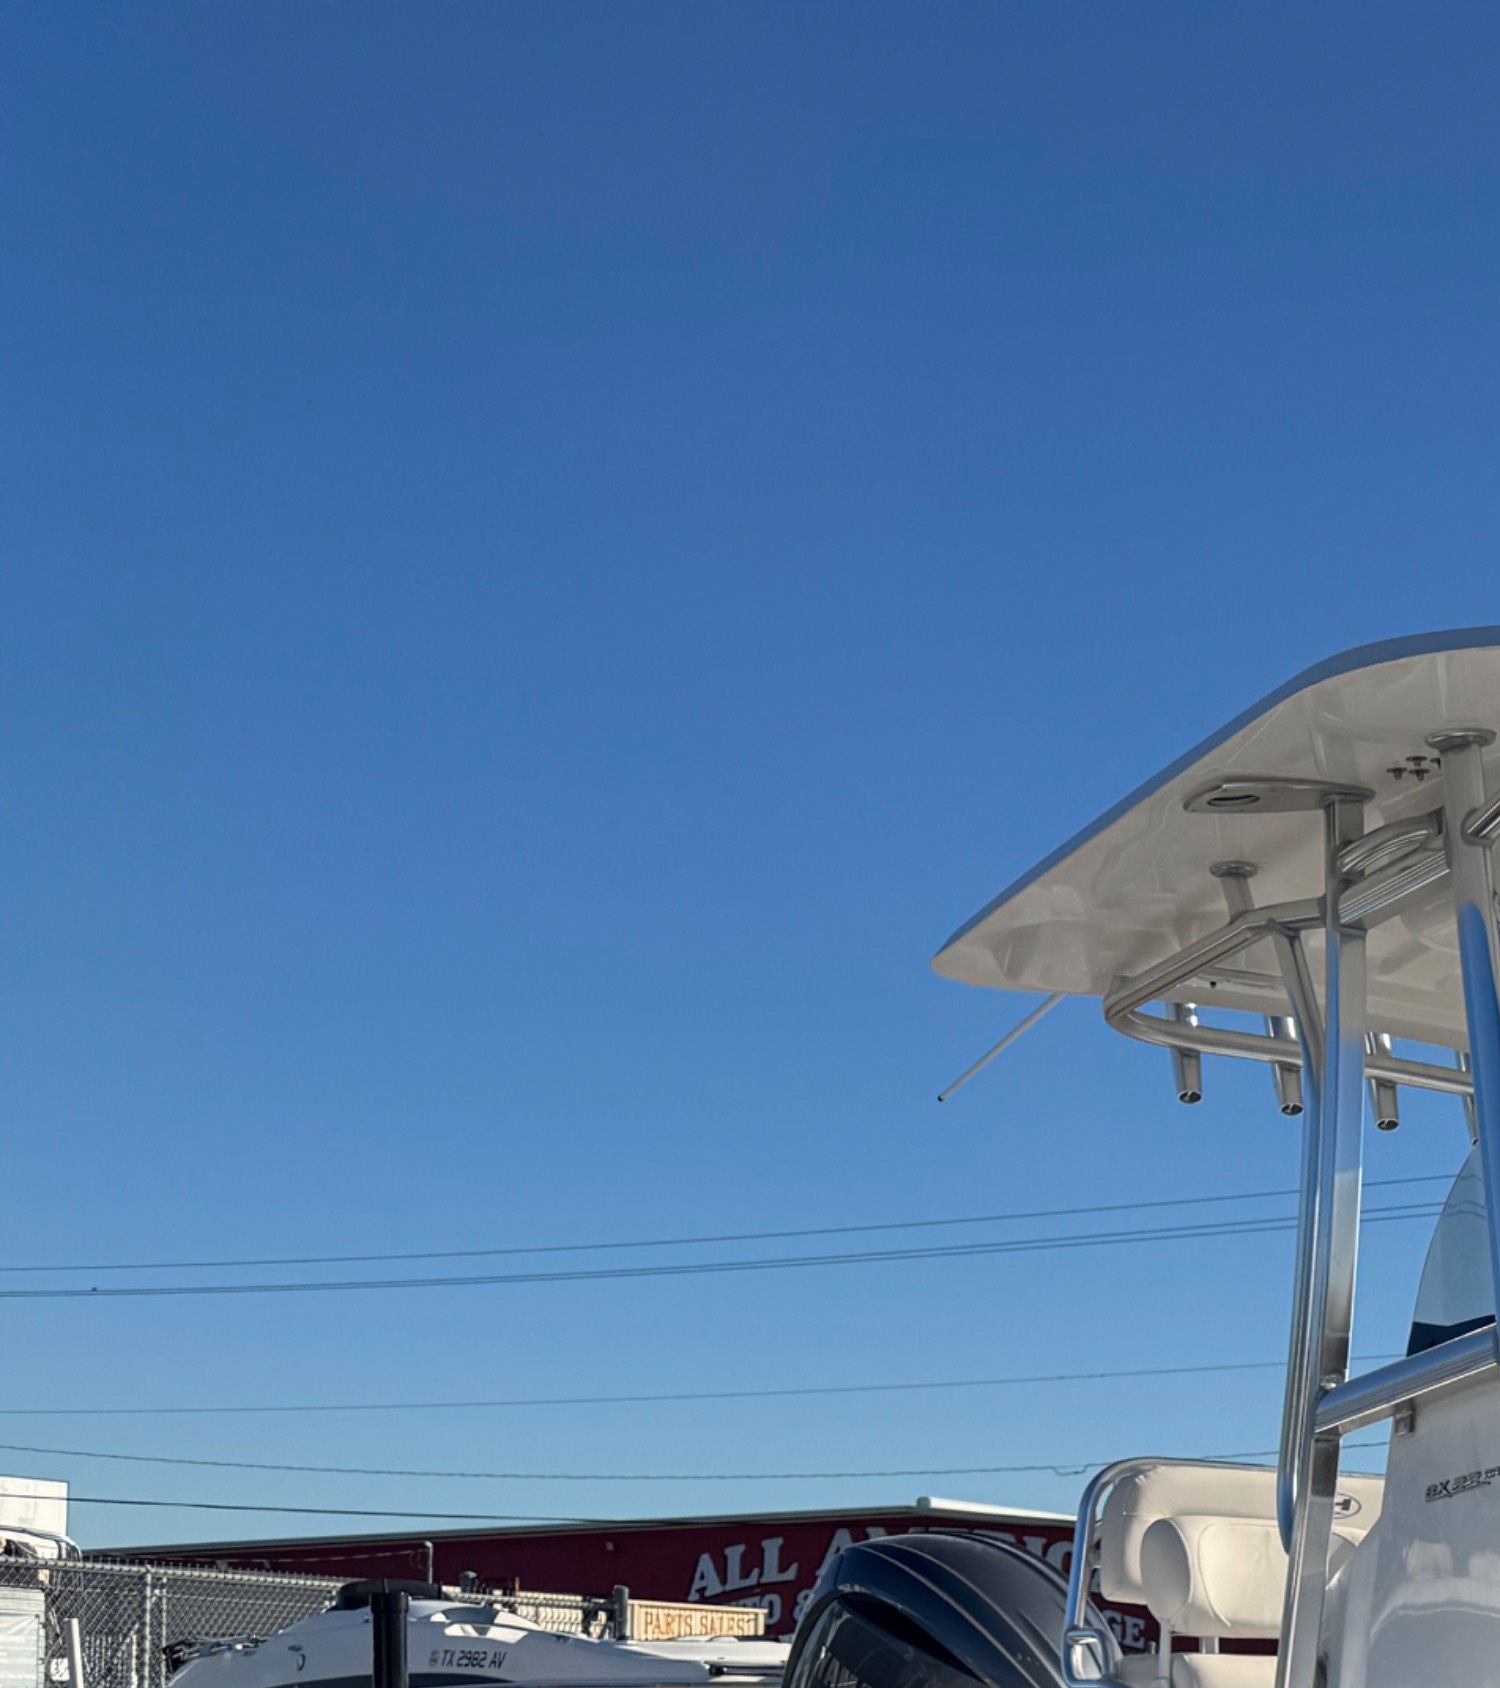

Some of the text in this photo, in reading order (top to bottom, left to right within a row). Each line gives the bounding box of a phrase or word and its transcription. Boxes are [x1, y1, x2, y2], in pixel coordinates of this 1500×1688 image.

[688, 1537, 798, 1601] ALL
[644, 1610, 694, 1637] PARTS
[442, 1648, 458, 1668] TX
[488, 1651, 508, 1670] AV
